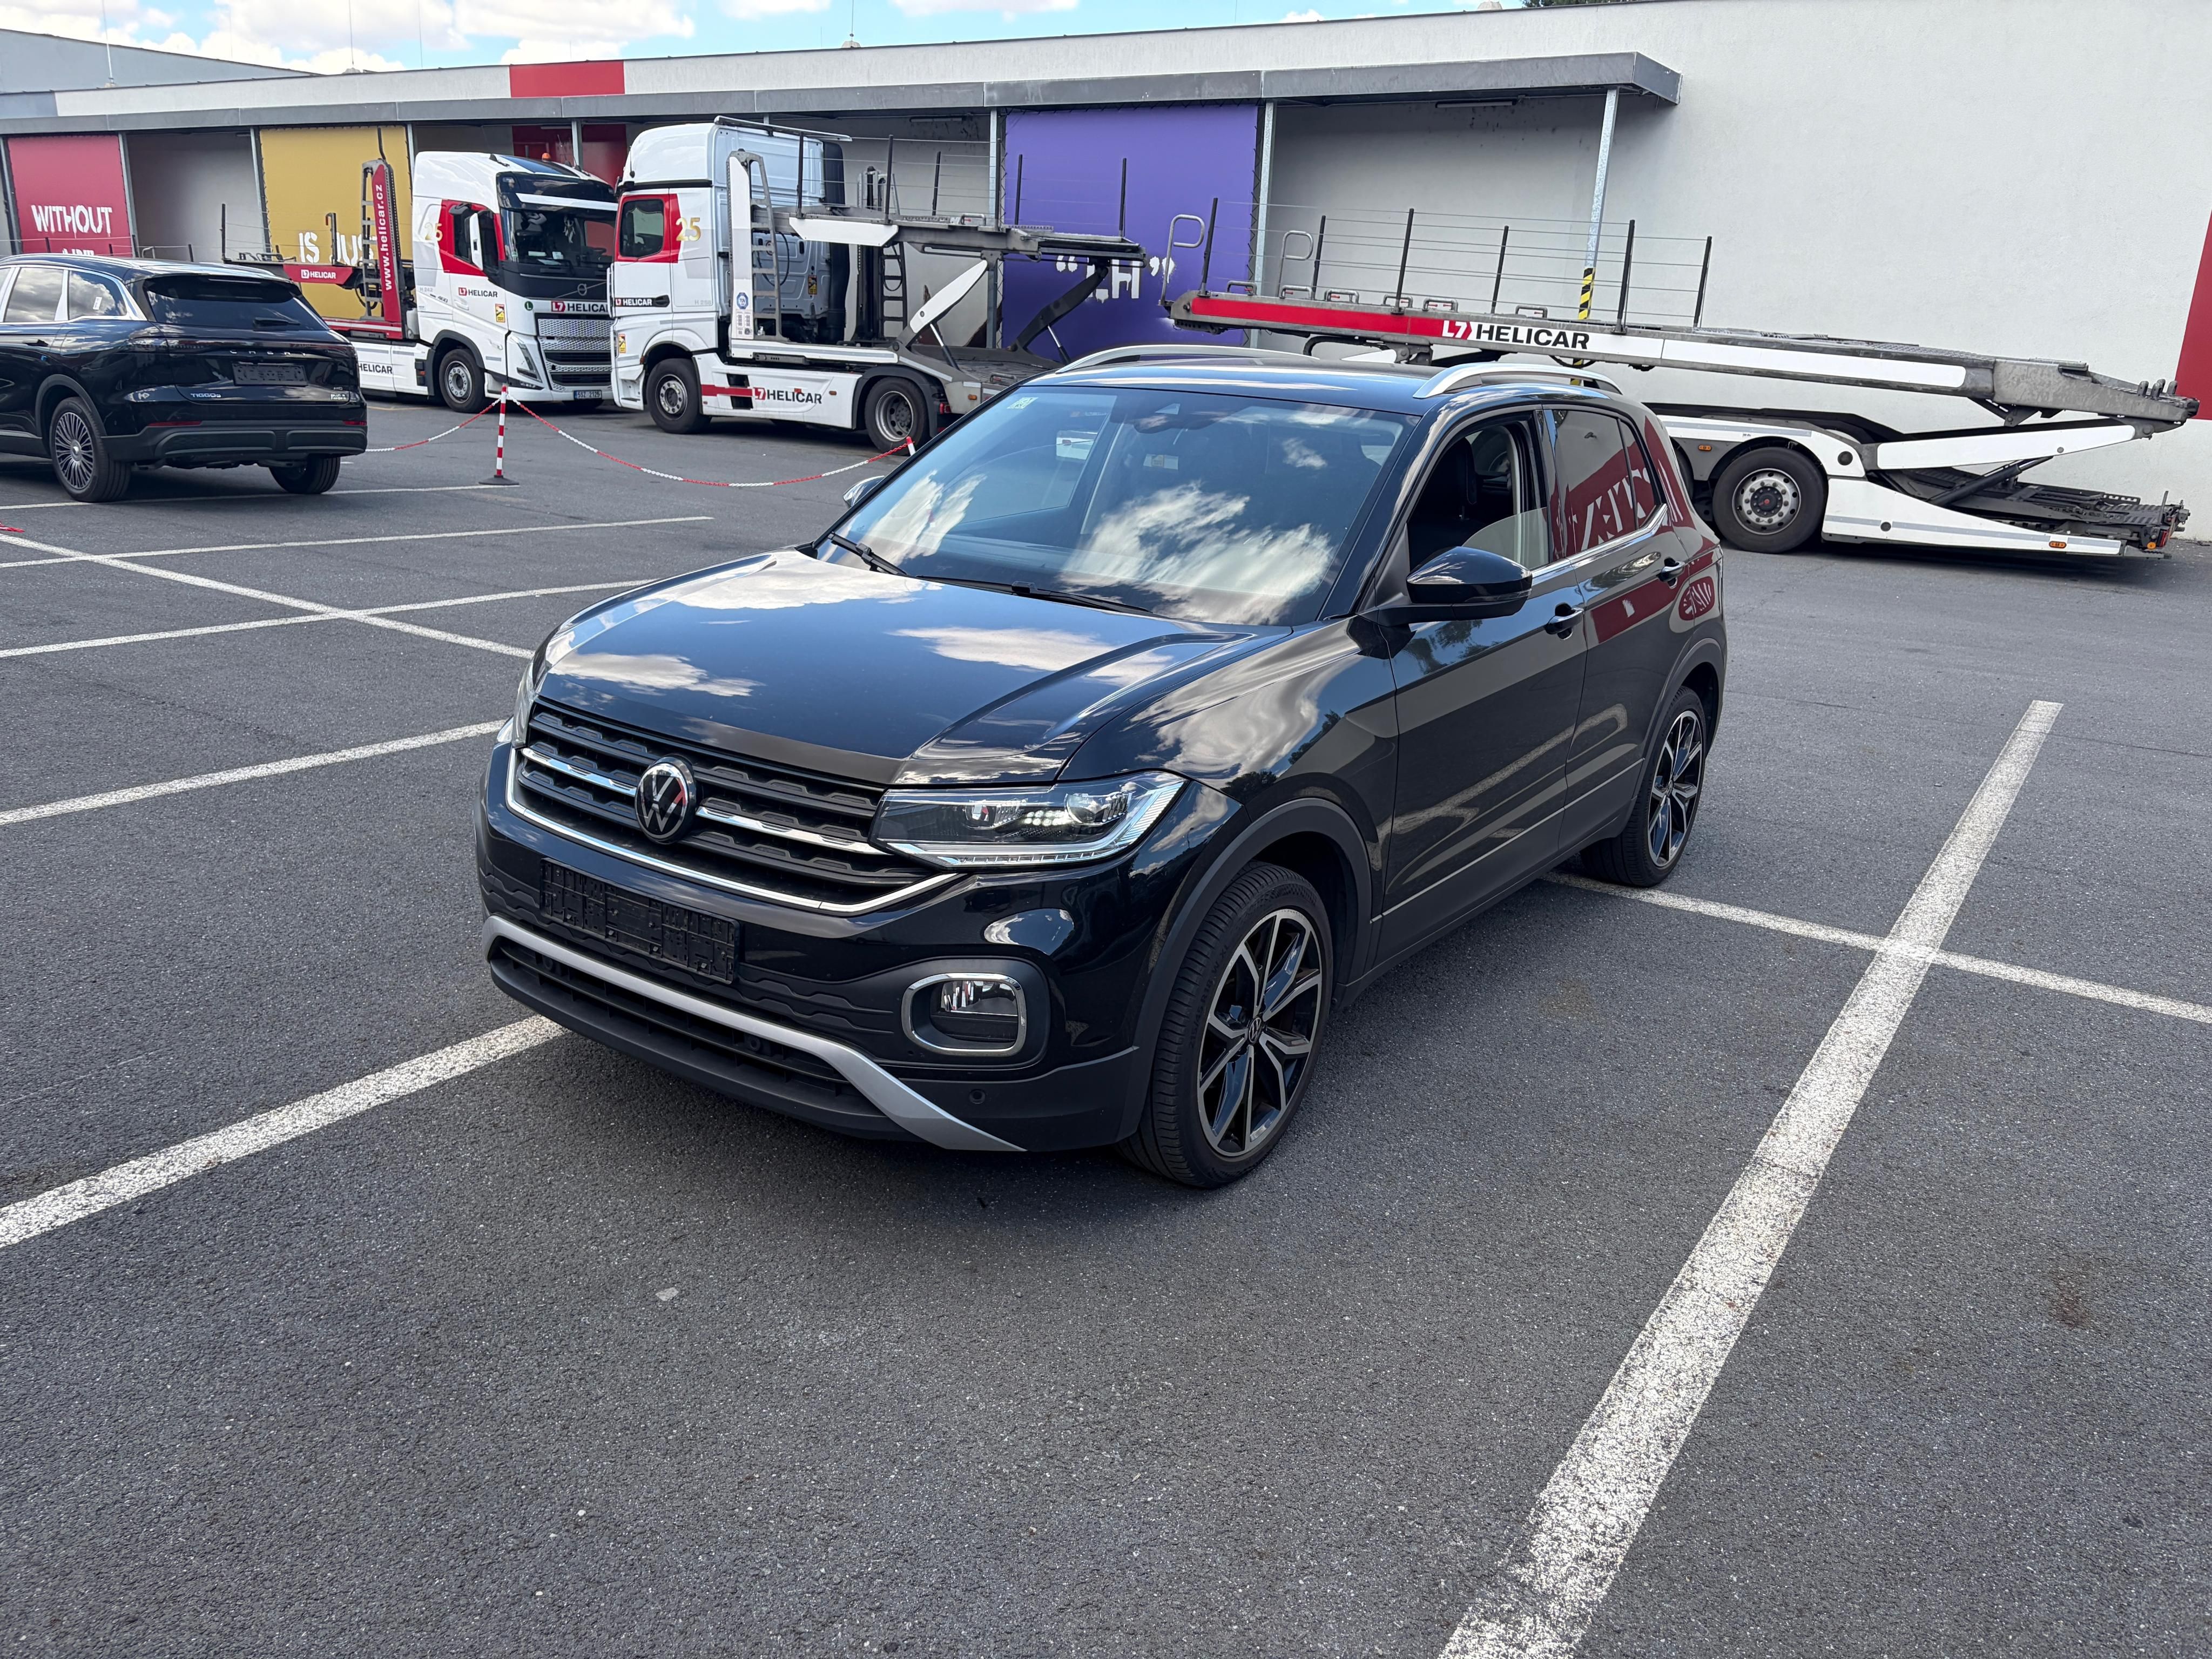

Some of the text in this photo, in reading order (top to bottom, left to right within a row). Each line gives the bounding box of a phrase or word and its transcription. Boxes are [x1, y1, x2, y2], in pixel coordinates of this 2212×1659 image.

[31, 205, 113, 234] WITHOUT
[375, 184, 392, 291] www.helicar.cz
[424, 222, 443, 241] 25
[676, 217, 701, 241] 25
[299, 232, 377, 266] IS JUS
[310, 271, 336, 279] HELICAR
[468, 289, 498, 298] HELICAR
[623, 298, 652, 306] HELICAR
[552, 301, 608, 313] L7 HELICA
[1441, 320, 1590, 350] L7 HELICAR
[359, 363, 393, 374] HELICAR
[752, 388, 822, 404] L7 HELICAR
